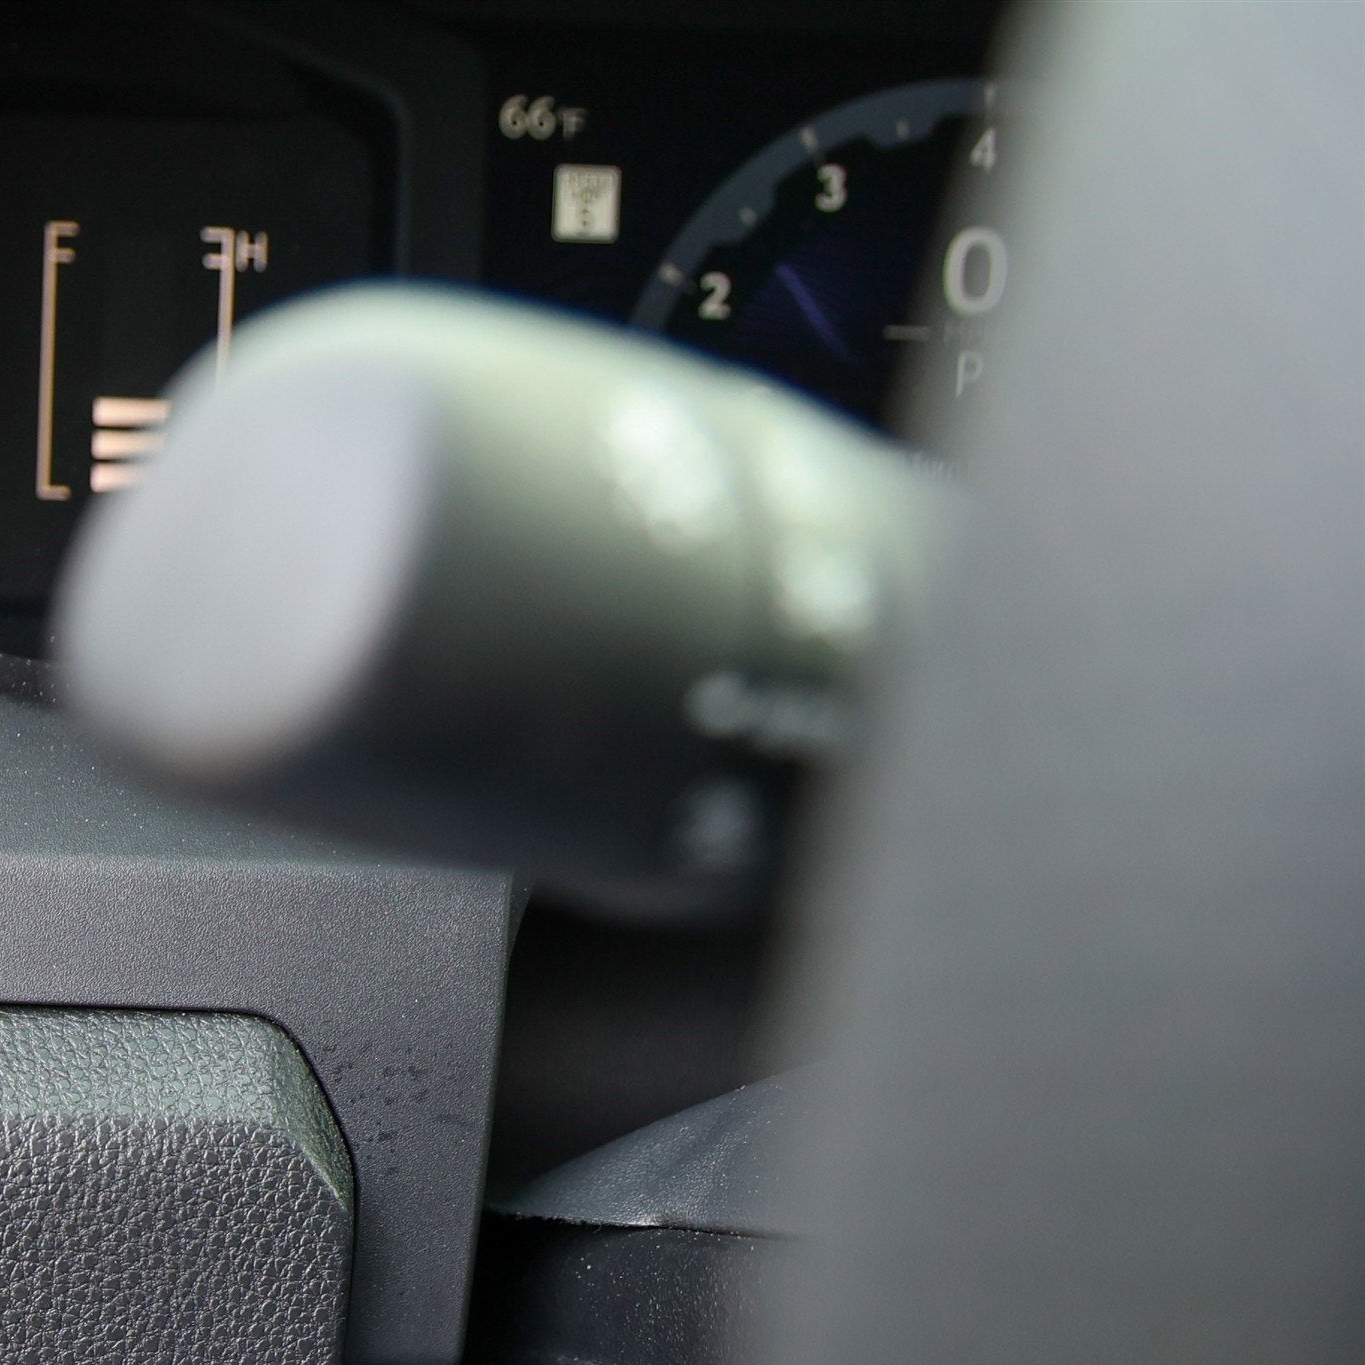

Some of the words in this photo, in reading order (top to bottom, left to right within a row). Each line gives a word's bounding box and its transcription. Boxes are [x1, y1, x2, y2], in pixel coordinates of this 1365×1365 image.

[970, 127, 997, 172] 4
[814, 164, 848, 212] 3
[698, 271, 732, 320] 2
[956, 350, 984, 397] P
